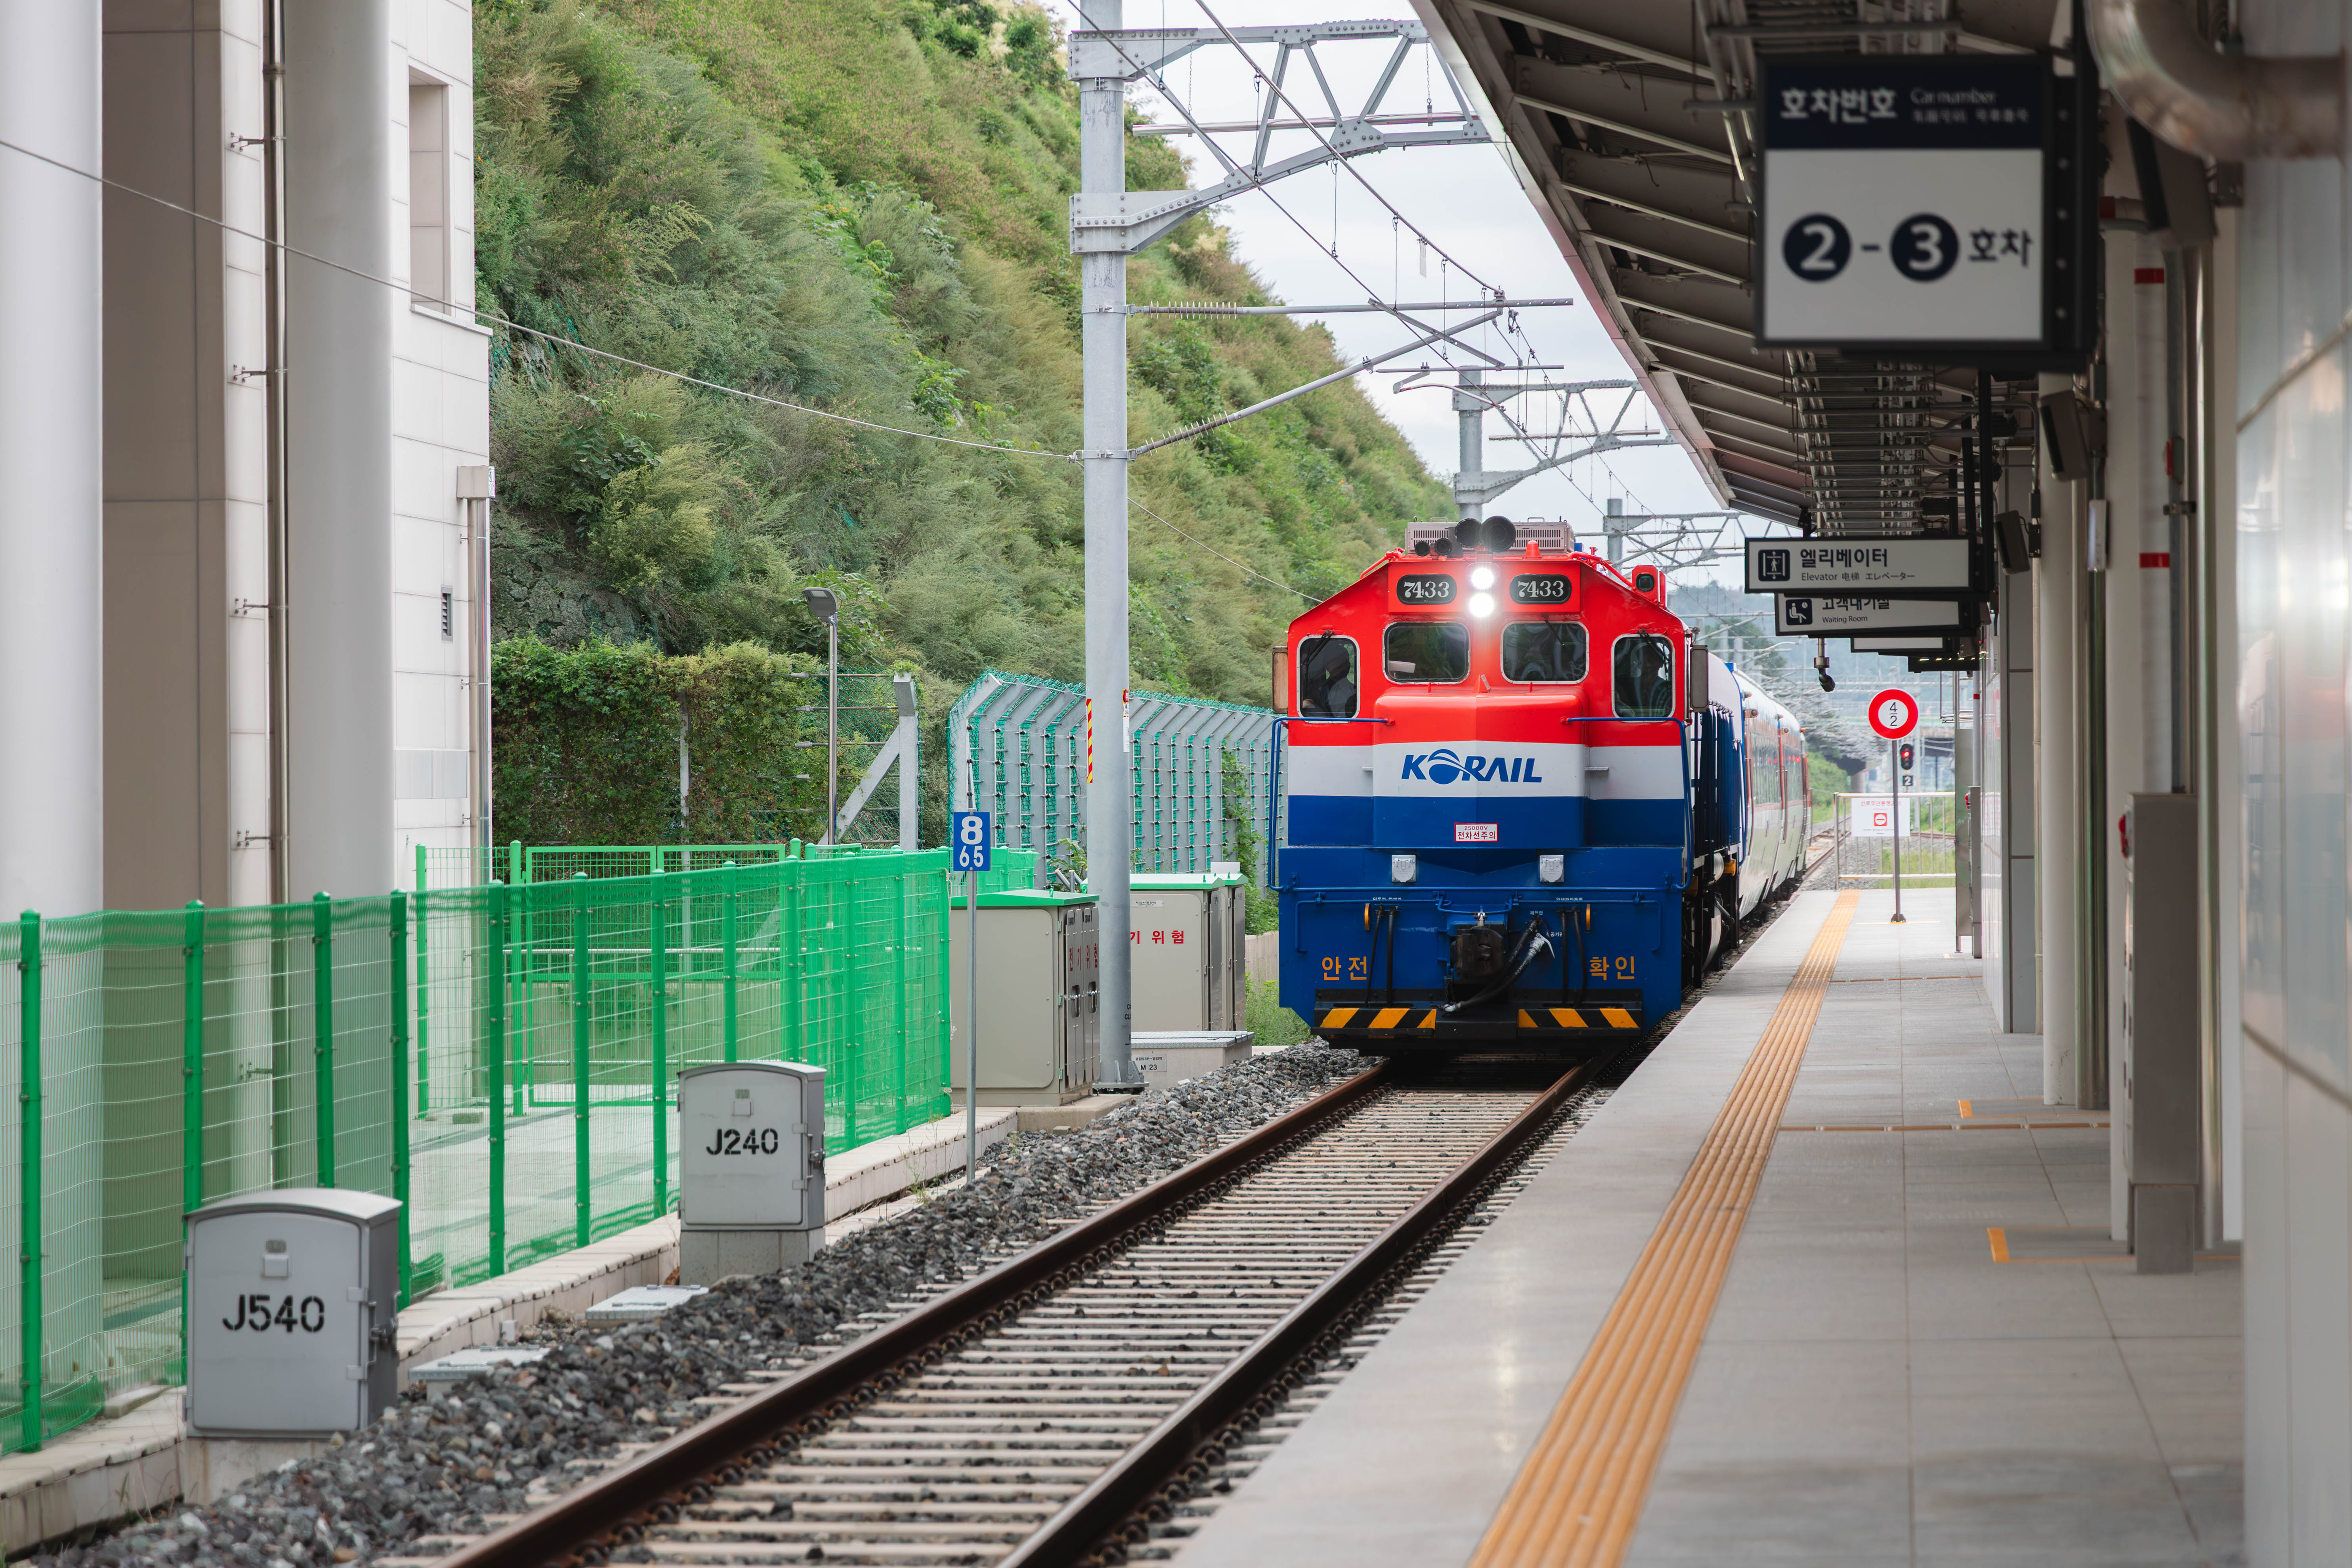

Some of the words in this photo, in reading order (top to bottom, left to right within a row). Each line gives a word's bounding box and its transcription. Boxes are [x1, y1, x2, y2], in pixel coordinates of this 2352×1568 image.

[1780, 87, 1898, 123] 호차번호
[1968, 229, 2032, 268] 호차
[1800, 548, 1887, 568] 엘리베이터
[1801, 572, 1838, 581] Elevator
[1841, 572, 1860, 581] 电梯
[1865, 572, 1915, 581] エレベーター
[1404, 581, 1450, 598] 7433
[1518, 580, 1564, 597] 7433
[1889, 701, 1898, 713] 4
[1890, 715, 1898, 727] 2
[1401, 749, 1542, 784] KORAIL
[1904, 776, 1912, 786] 2
[961, 816, 983, 845] 8
[1458, 831, 1495, 839] 전차선주의
[959, 845, 984, 867] 65
[1152, 930, 1184, 944] 위험
[1322, 956, 1367, 980] 안전
[1589, 956, 1635, 980] 확인
[706, 1128, 778, 1155] J240
[222, 1294, 325, 1333] J540
